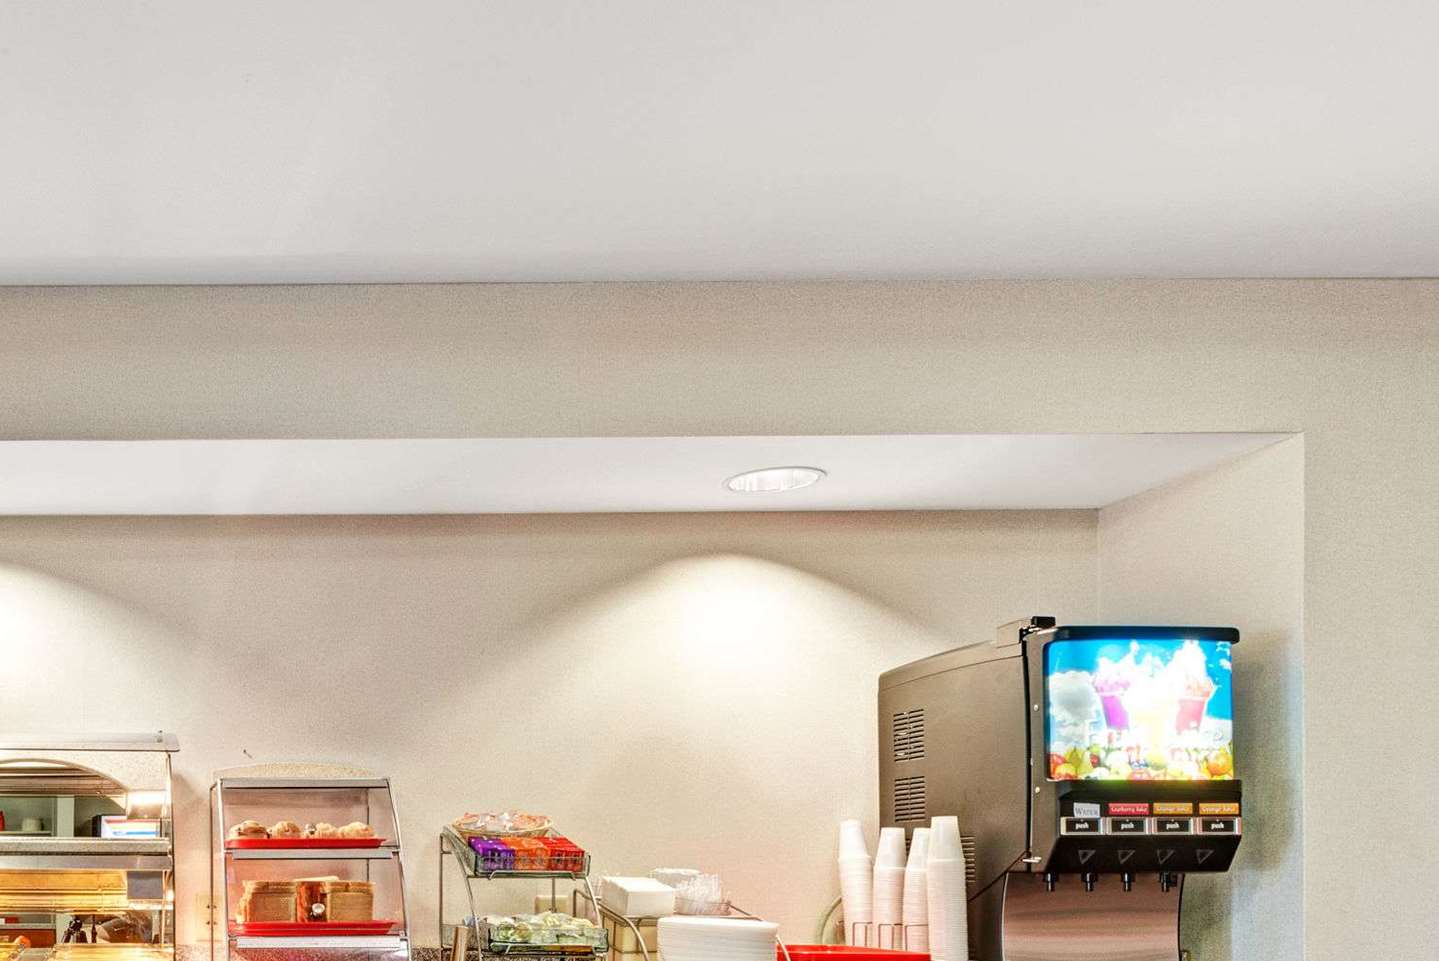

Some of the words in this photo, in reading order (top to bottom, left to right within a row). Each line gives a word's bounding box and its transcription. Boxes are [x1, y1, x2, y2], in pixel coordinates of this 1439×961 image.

[1075, 821, 1089, 830] push
[1120, 821, 1135, 830] push
[1166, 821, 1180, 830] push
[1211, 821, 1224, 830] push
